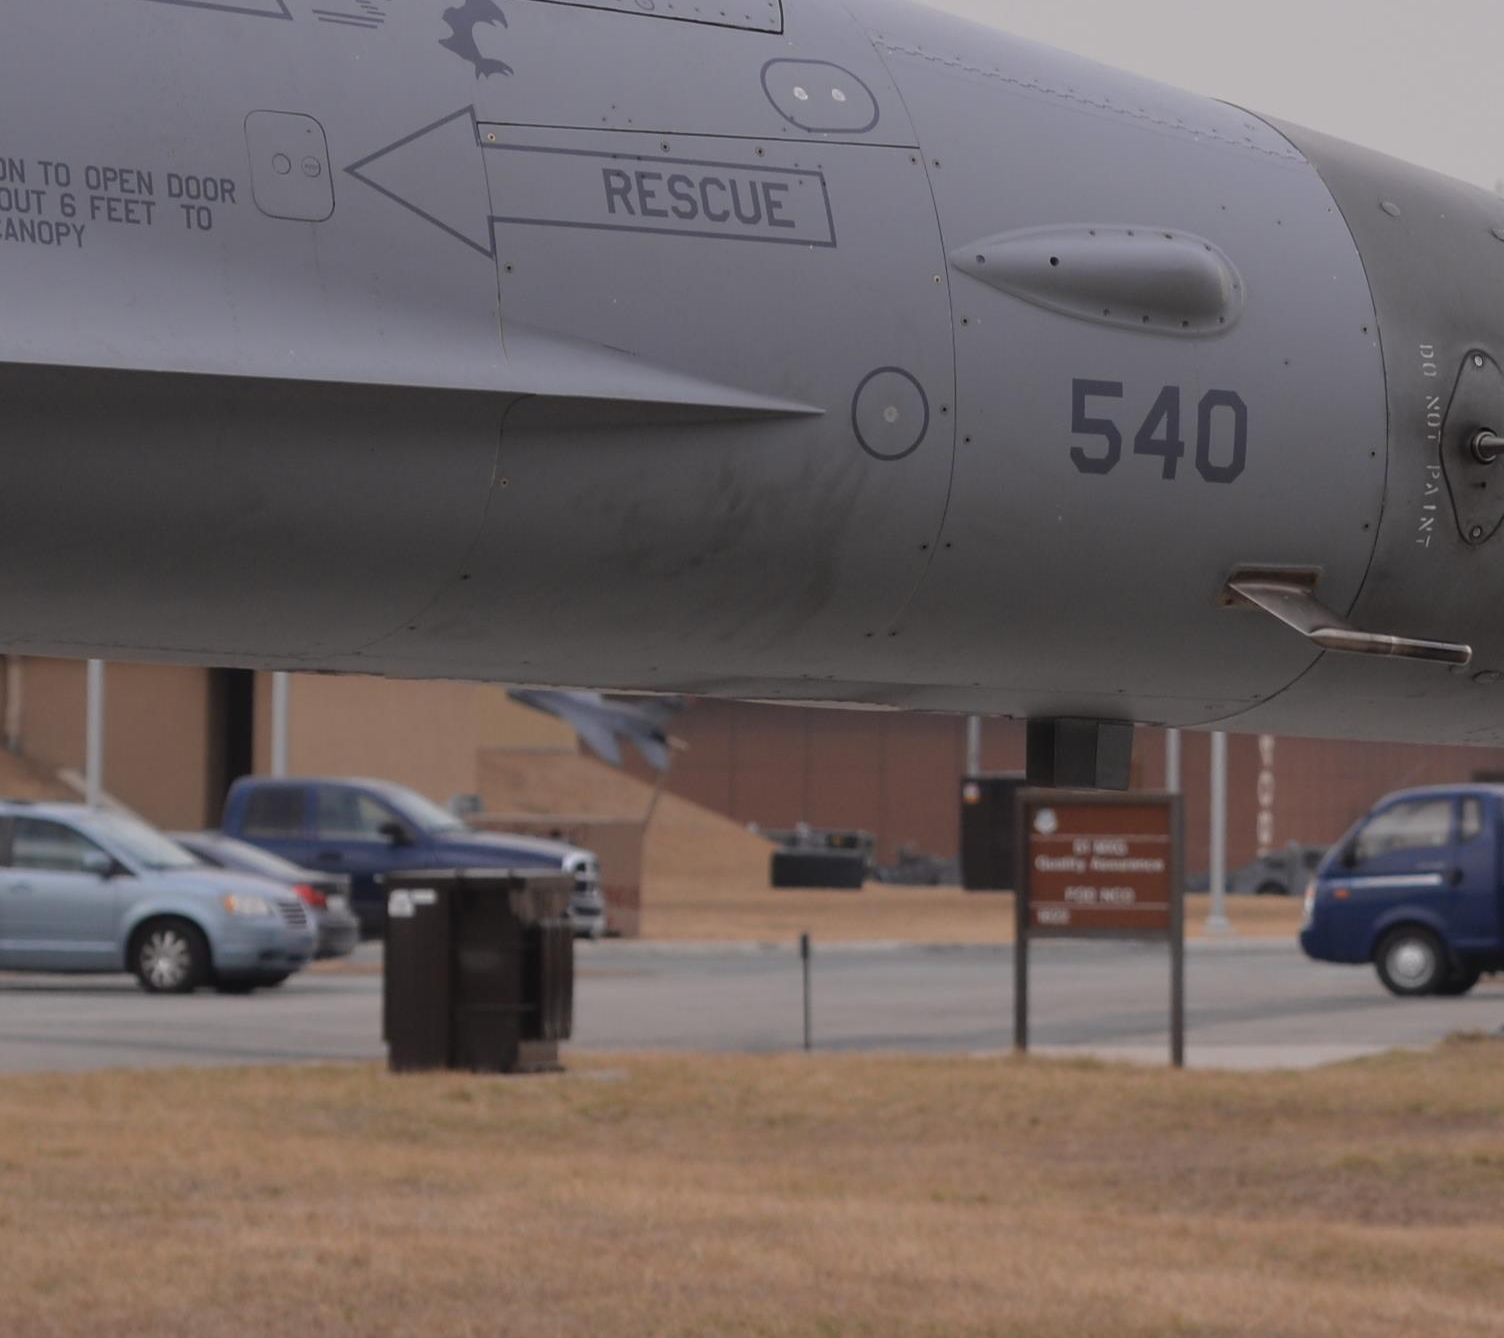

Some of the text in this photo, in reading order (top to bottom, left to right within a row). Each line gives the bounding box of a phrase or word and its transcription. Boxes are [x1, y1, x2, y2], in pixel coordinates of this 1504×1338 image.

[37, 160, 71, 188] TO
[84, 165, 154, 196] OPEN
[166, 173, 237, 205] DOOR
[602, 168, 796, 229] RESCUE
[59, 192, 77, 218] 6
[89, 195, 157, 226] FEET
[180, 204, 213, 232] TO
[1069, 377, 1249, 485] 540
[1415, 344, 1442, 549] DO NOT PAINT
[1034, 855, 1166, 874] Quality Assurance
